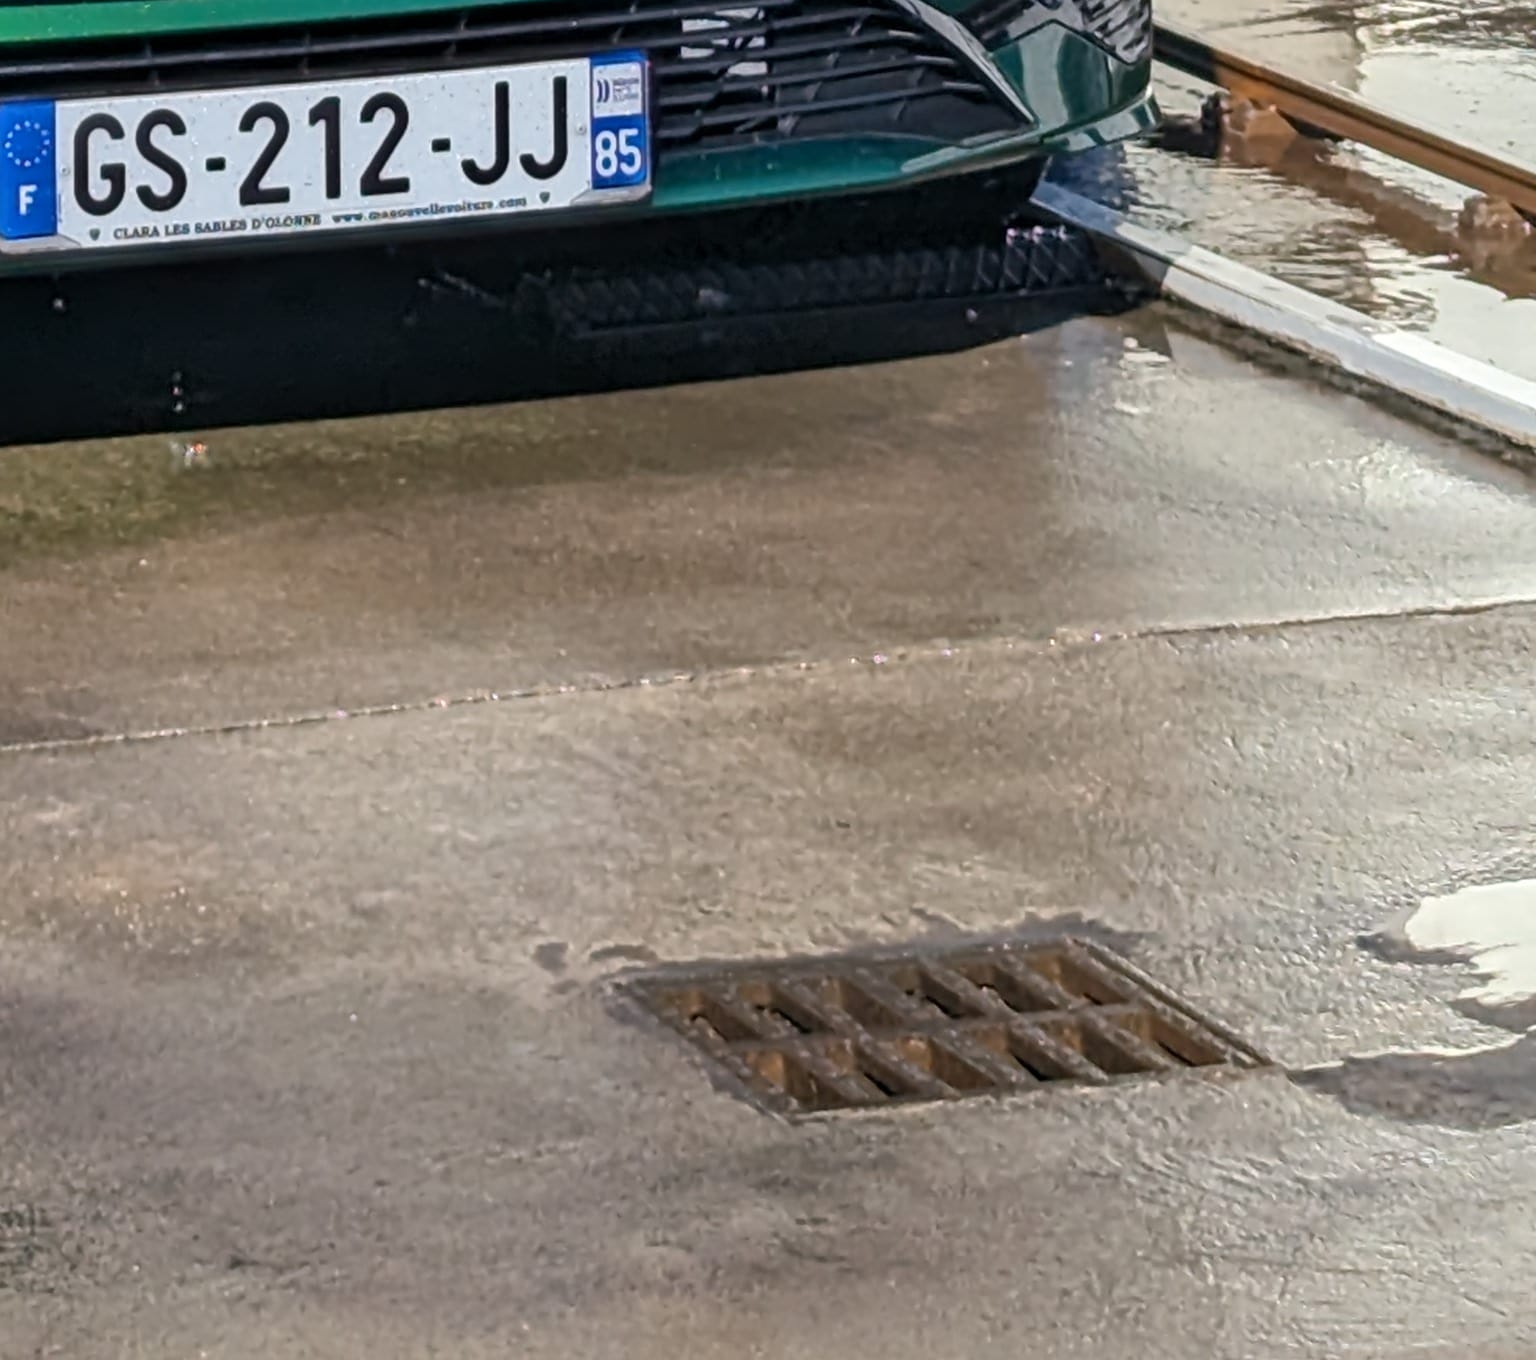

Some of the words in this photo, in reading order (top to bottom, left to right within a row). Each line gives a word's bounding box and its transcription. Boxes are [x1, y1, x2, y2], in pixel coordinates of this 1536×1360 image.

[18, 184, 38, 217] F
[72, 75, 568, 216] GS-212-JJ
[594, 127, 642, 178] 85
[113, 226, 161, 241] CLARA
[164, 222, 191, 237] LES
[194, 218, 247, 234] SABLES
